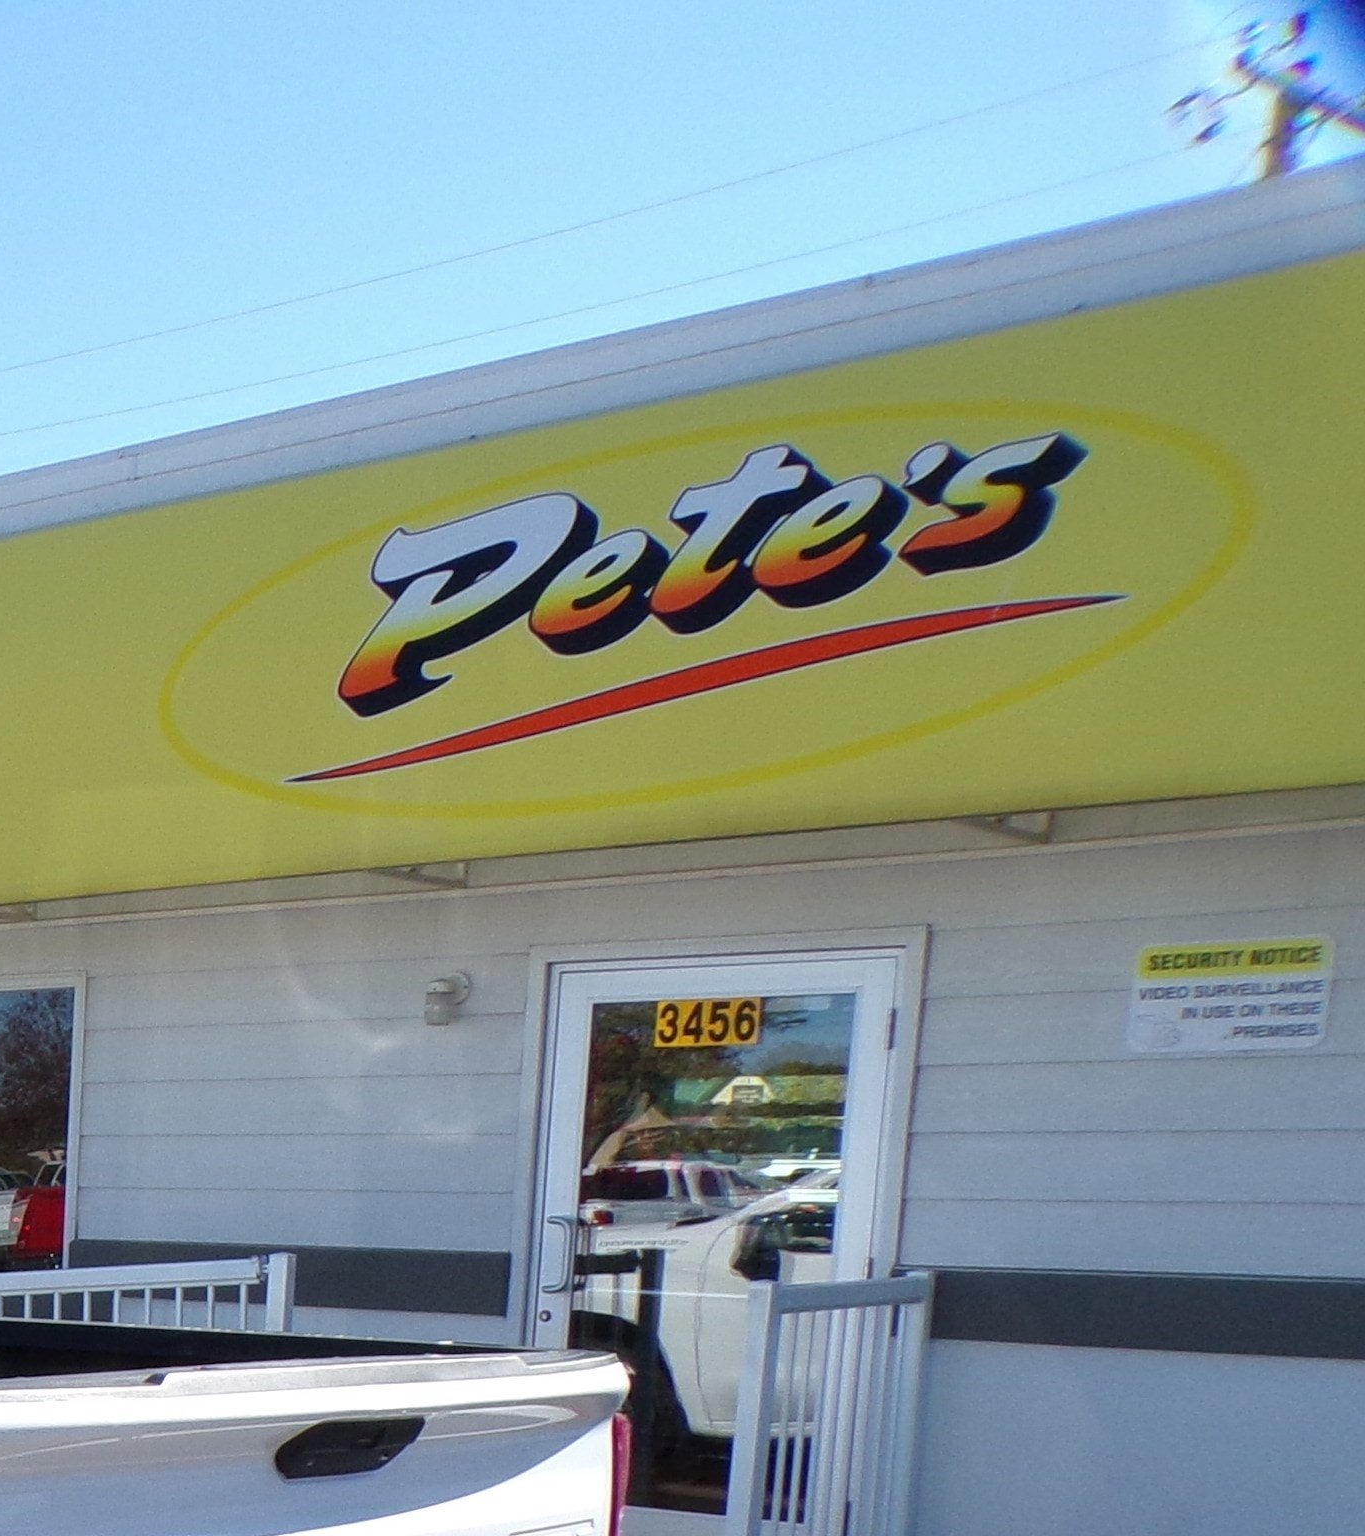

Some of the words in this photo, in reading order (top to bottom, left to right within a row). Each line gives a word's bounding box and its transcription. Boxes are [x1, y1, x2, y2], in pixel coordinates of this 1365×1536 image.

[337, 430, 1089, 718] Pete's
[1147, 950, 1244, 971] SECURITY
[1249, 945, 1322, 965] NOTICE
[1139, 986, 1189, 1001] VIDEO
[1192, 979, 1324, 999] SURVEILLANCE
[1180, 1006, 1197, 1020] IN
[1201, 1004, 1235, 1019] USE
[1239, 1003, 1264, 1017] ON
[1267, 1001, 1322, 1016] THESE
[658, 1001, 757, 1045] 3456
[1232, 1022, 1319, 1039] PREMISES
